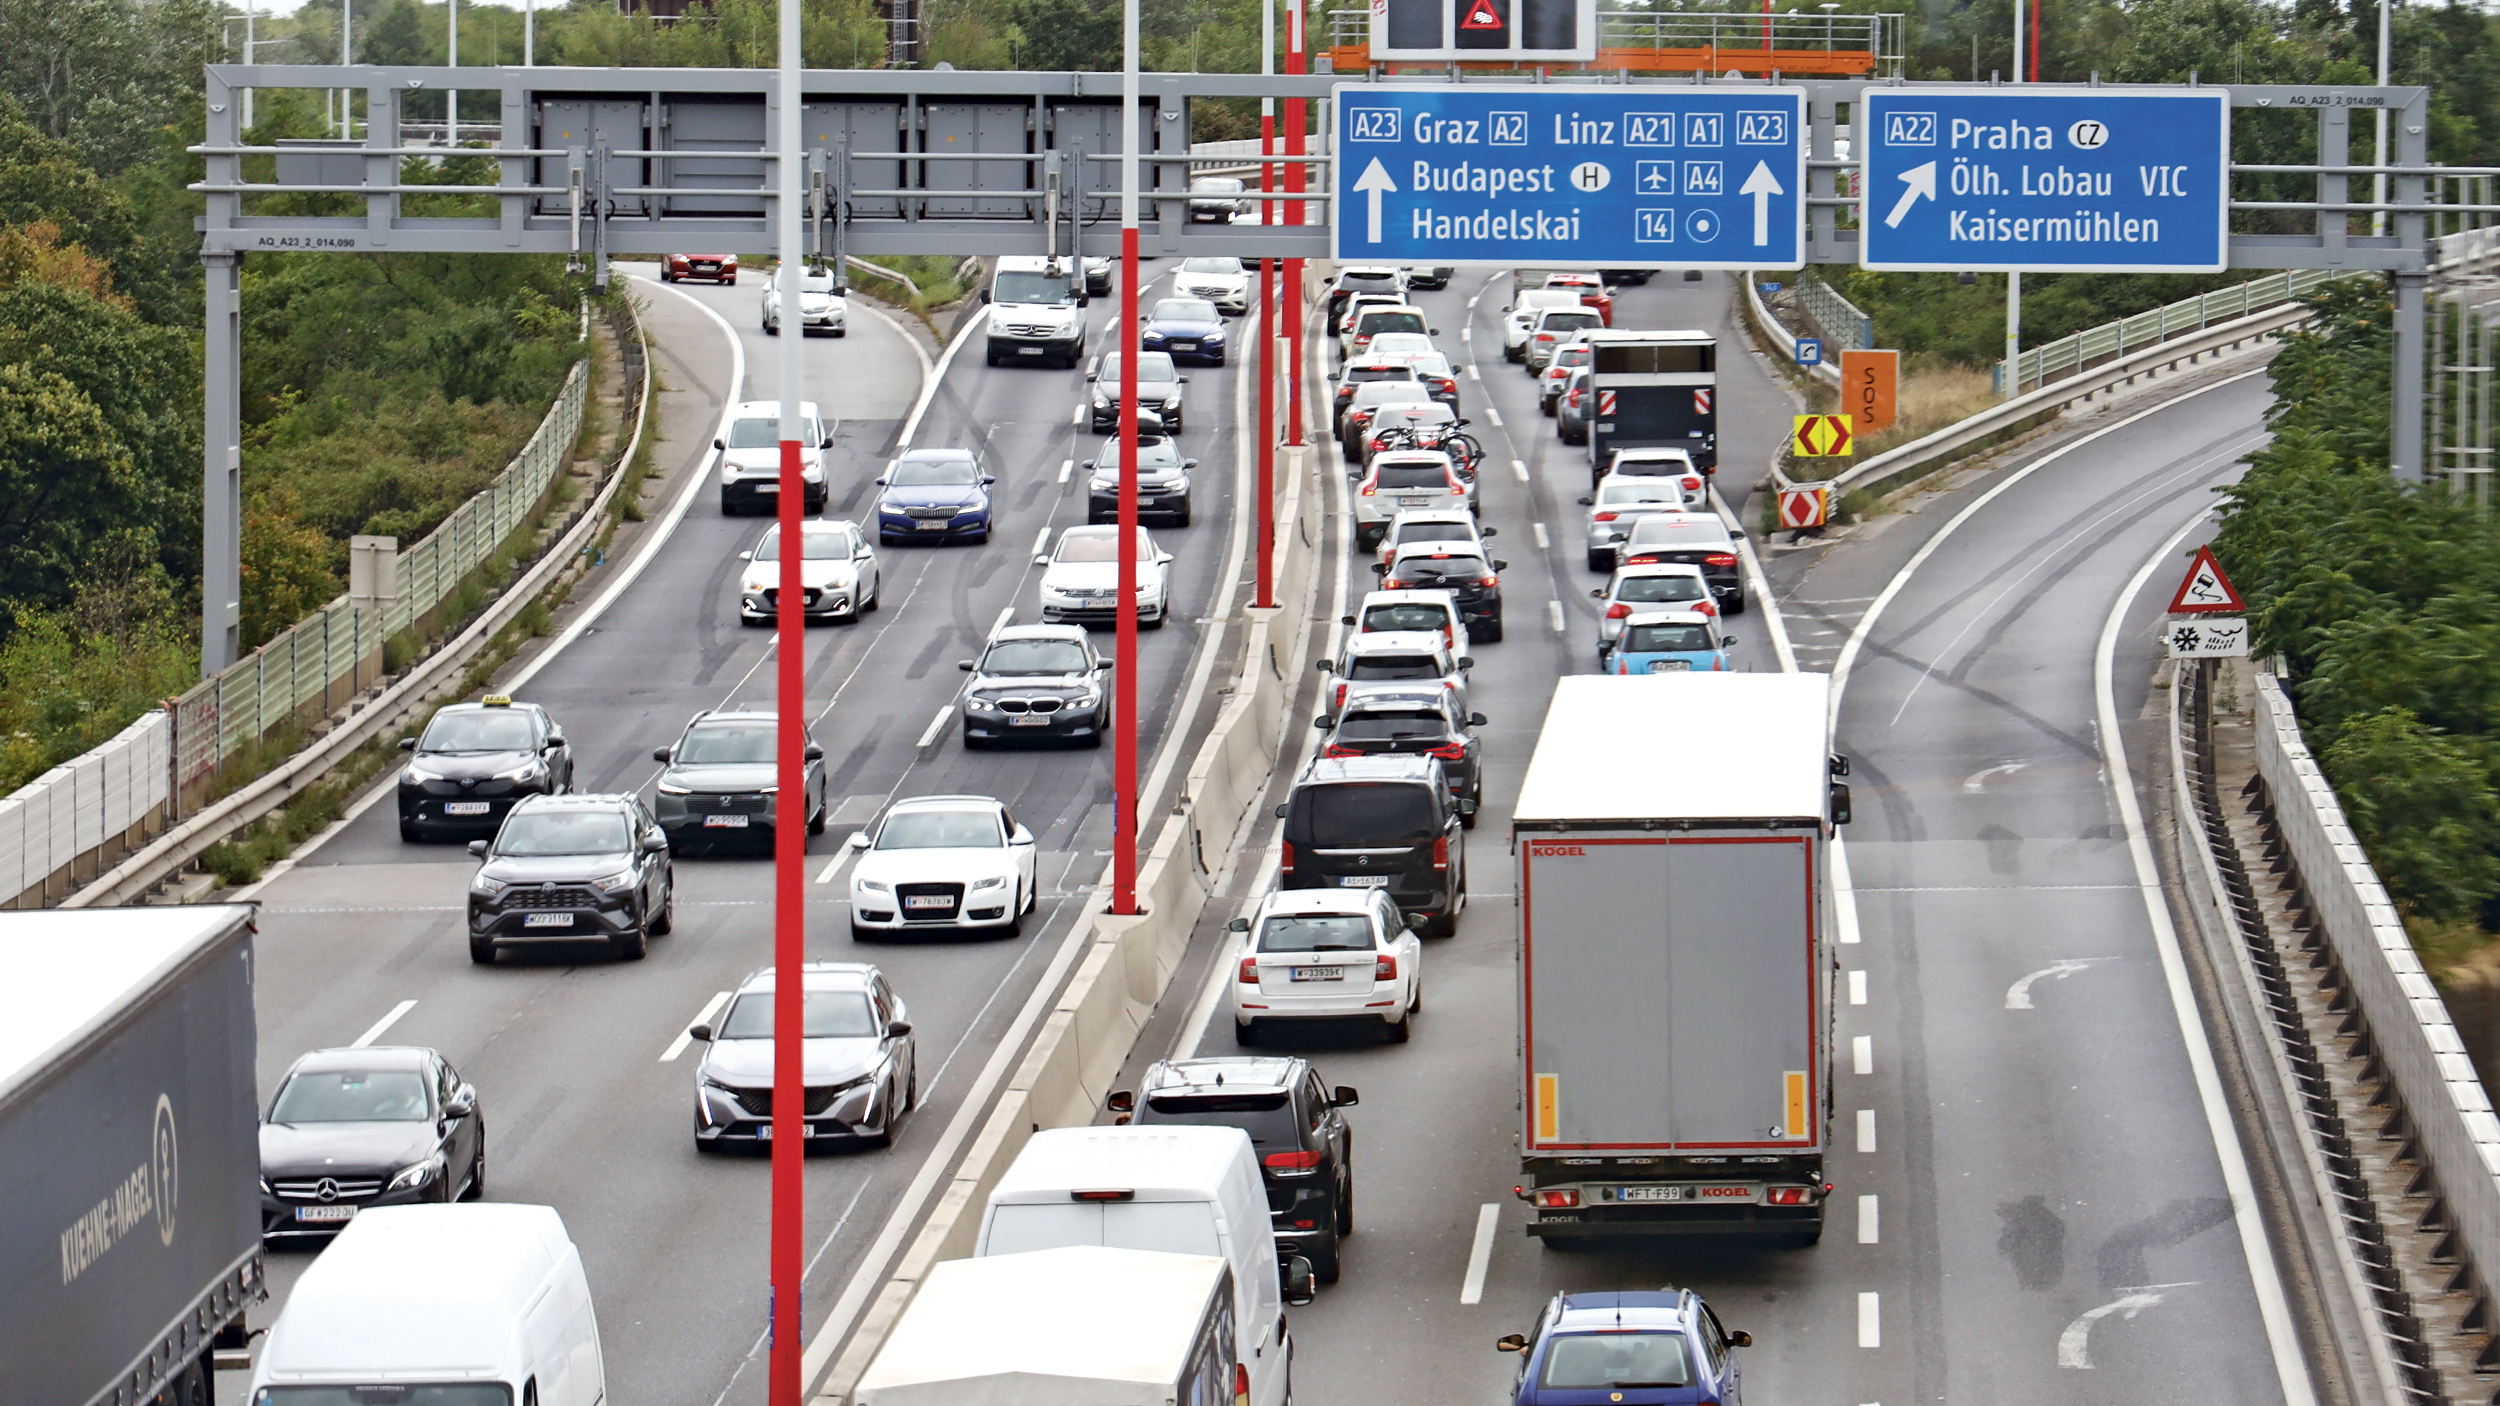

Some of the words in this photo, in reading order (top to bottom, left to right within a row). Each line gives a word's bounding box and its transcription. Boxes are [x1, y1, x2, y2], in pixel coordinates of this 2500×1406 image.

[1355, 113, 1397, 138] A23
[1414, 112, 1480, 144] Graz
[1494, 116, 1523, 141] A2
[1554, 112, 1615, 145] Linz
[1629, 117, 1670, 142] A21
[1691, 117, 1717, 142] A1
[1741, 115, 1783, 141] A23
[1889, 116, 1932, 143] A22
[1951, 118, 2053, 150] Praha
[2076, 123, 2101, 146] CZ
[1413, 160, 1555, 199] Budapest
[1583, 166, 1598, 188] H
[1688, 165, 1719, 190] A4
[1951, 156, 2009, 196] Ölh.
[2022, 165, 2112, 196] Lobau
[2139, 165, 2188, 197] VIC
[1412, 207, 1580, 241] Handelskai
[1642, 213, 1668, 238] 14
[1950, 208, 2159, 243] Kaisermühlen
[1863, 366, 1875, 424] SOS
[1309, 967, 1341, 977] 33939K
[1626, 1187, 1678, 1199] WFT-F99
[61, 1162, 153, 1287] KUEHNE+NAGEL
